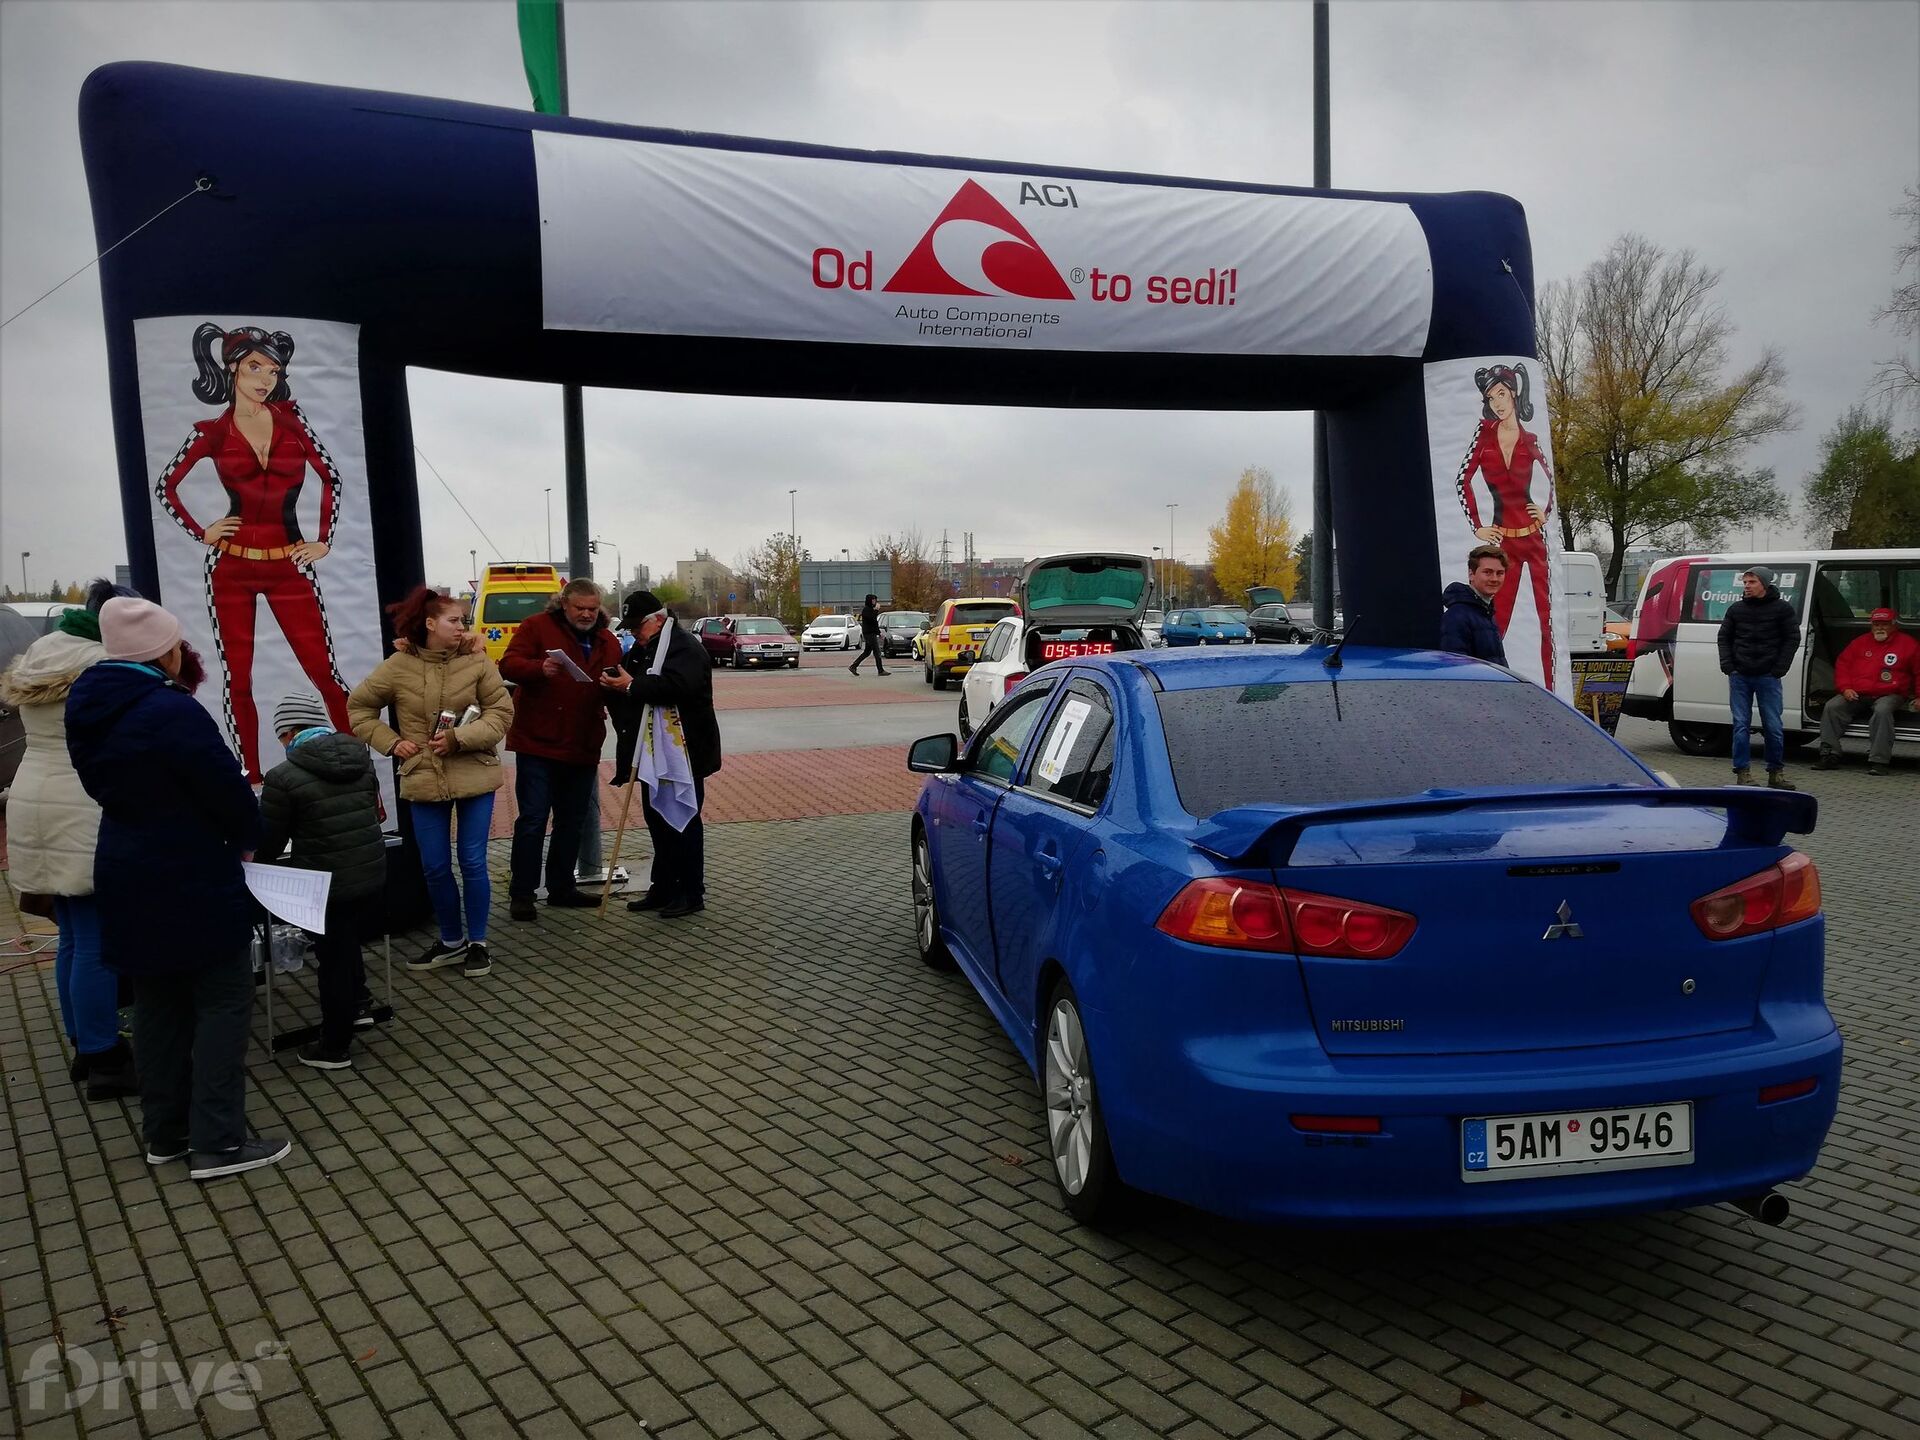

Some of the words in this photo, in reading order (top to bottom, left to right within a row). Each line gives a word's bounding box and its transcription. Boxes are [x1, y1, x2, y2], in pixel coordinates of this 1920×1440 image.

[1018, 181, 1080, 209] ACI
[811, 247, 873, 292] Od
[1089, 267, 1132, 304] to
[1145, 268, 1238, 306] sedí!
[895, 304, 940, 320] Auto
[945, 306, 1061, 325] Components
[918, 321, 1033, 340] International
[1045, 643, 1112, 658] 09:57:35
[1572, 662, 1587, 672] ZDE
[1587, 661, 1633, 672] MONTUJEME
[1331, 1018, 1405, 1032] MITSUBISHI
[1495, 1119, 1562, 1161] 5AM
[1589, 1111, 1674, 1154] 9546
[1467, 1151, 1485, 1163] CZ
